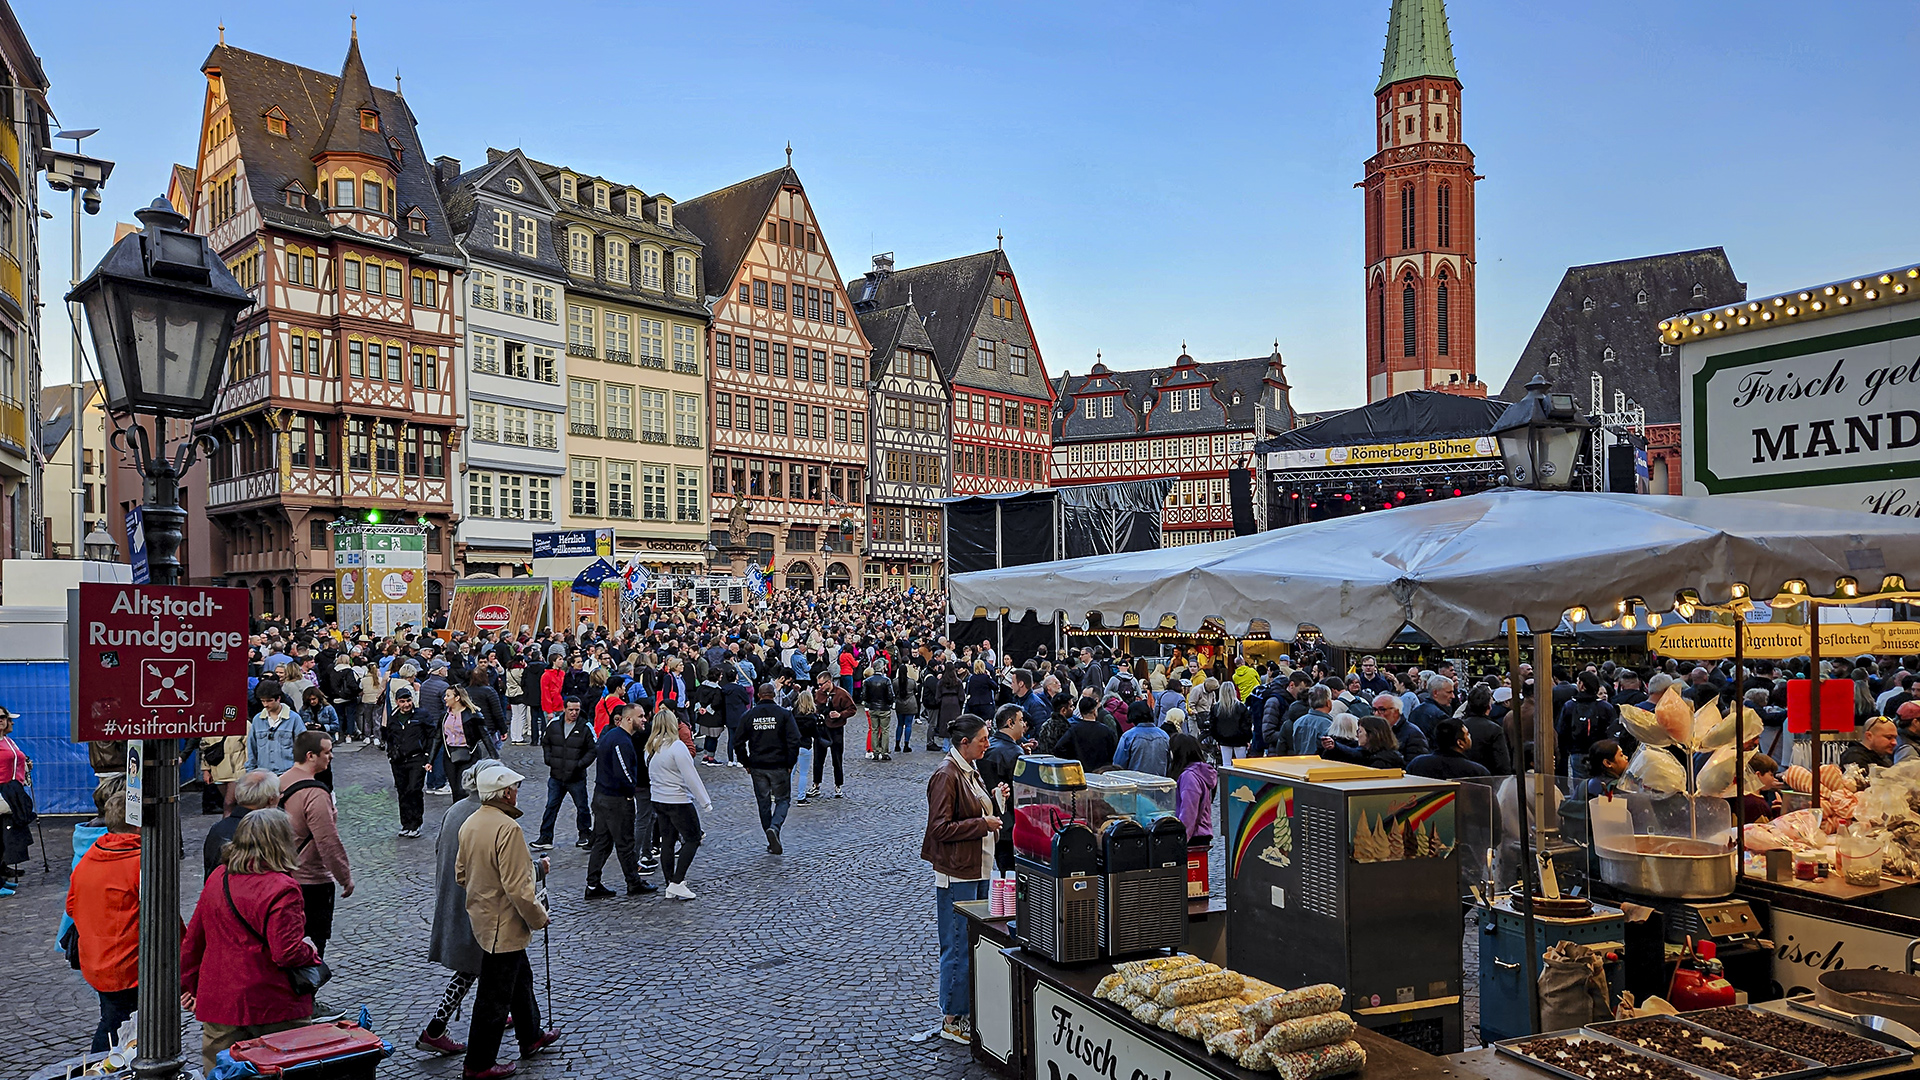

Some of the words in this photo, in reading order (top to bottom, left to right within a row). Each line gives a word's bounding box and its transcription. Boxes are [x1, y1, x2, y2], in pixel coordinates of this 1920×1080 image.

[1733, 358, 1848, 407] Frisch
[1752, 410, 1920, 464] MAND
[1351, 441, 1471, 461] Römerberg-Bühne
[558, 534, 586, 544] Herzlich
[646, 540, 697, 551] Geschenke
[111, 589, 222, 616] Altstadt-
[90, 621, 242, 653] Rundgänge
[1659, 635, 1733, 649] Zuckerwatte
[1746, 633, 1803, 650] agenbrot
[1818, 633, 1870, 646] osflocken
[1888, 627, 1920, 637] gebrann
[225, 707, 236, 716] OG
[102, 715, 227, 736] #visitfrankfurt
[1775, 935, 1848, 970] isch
[1051, 1004, 1118, 1080] Frisch
